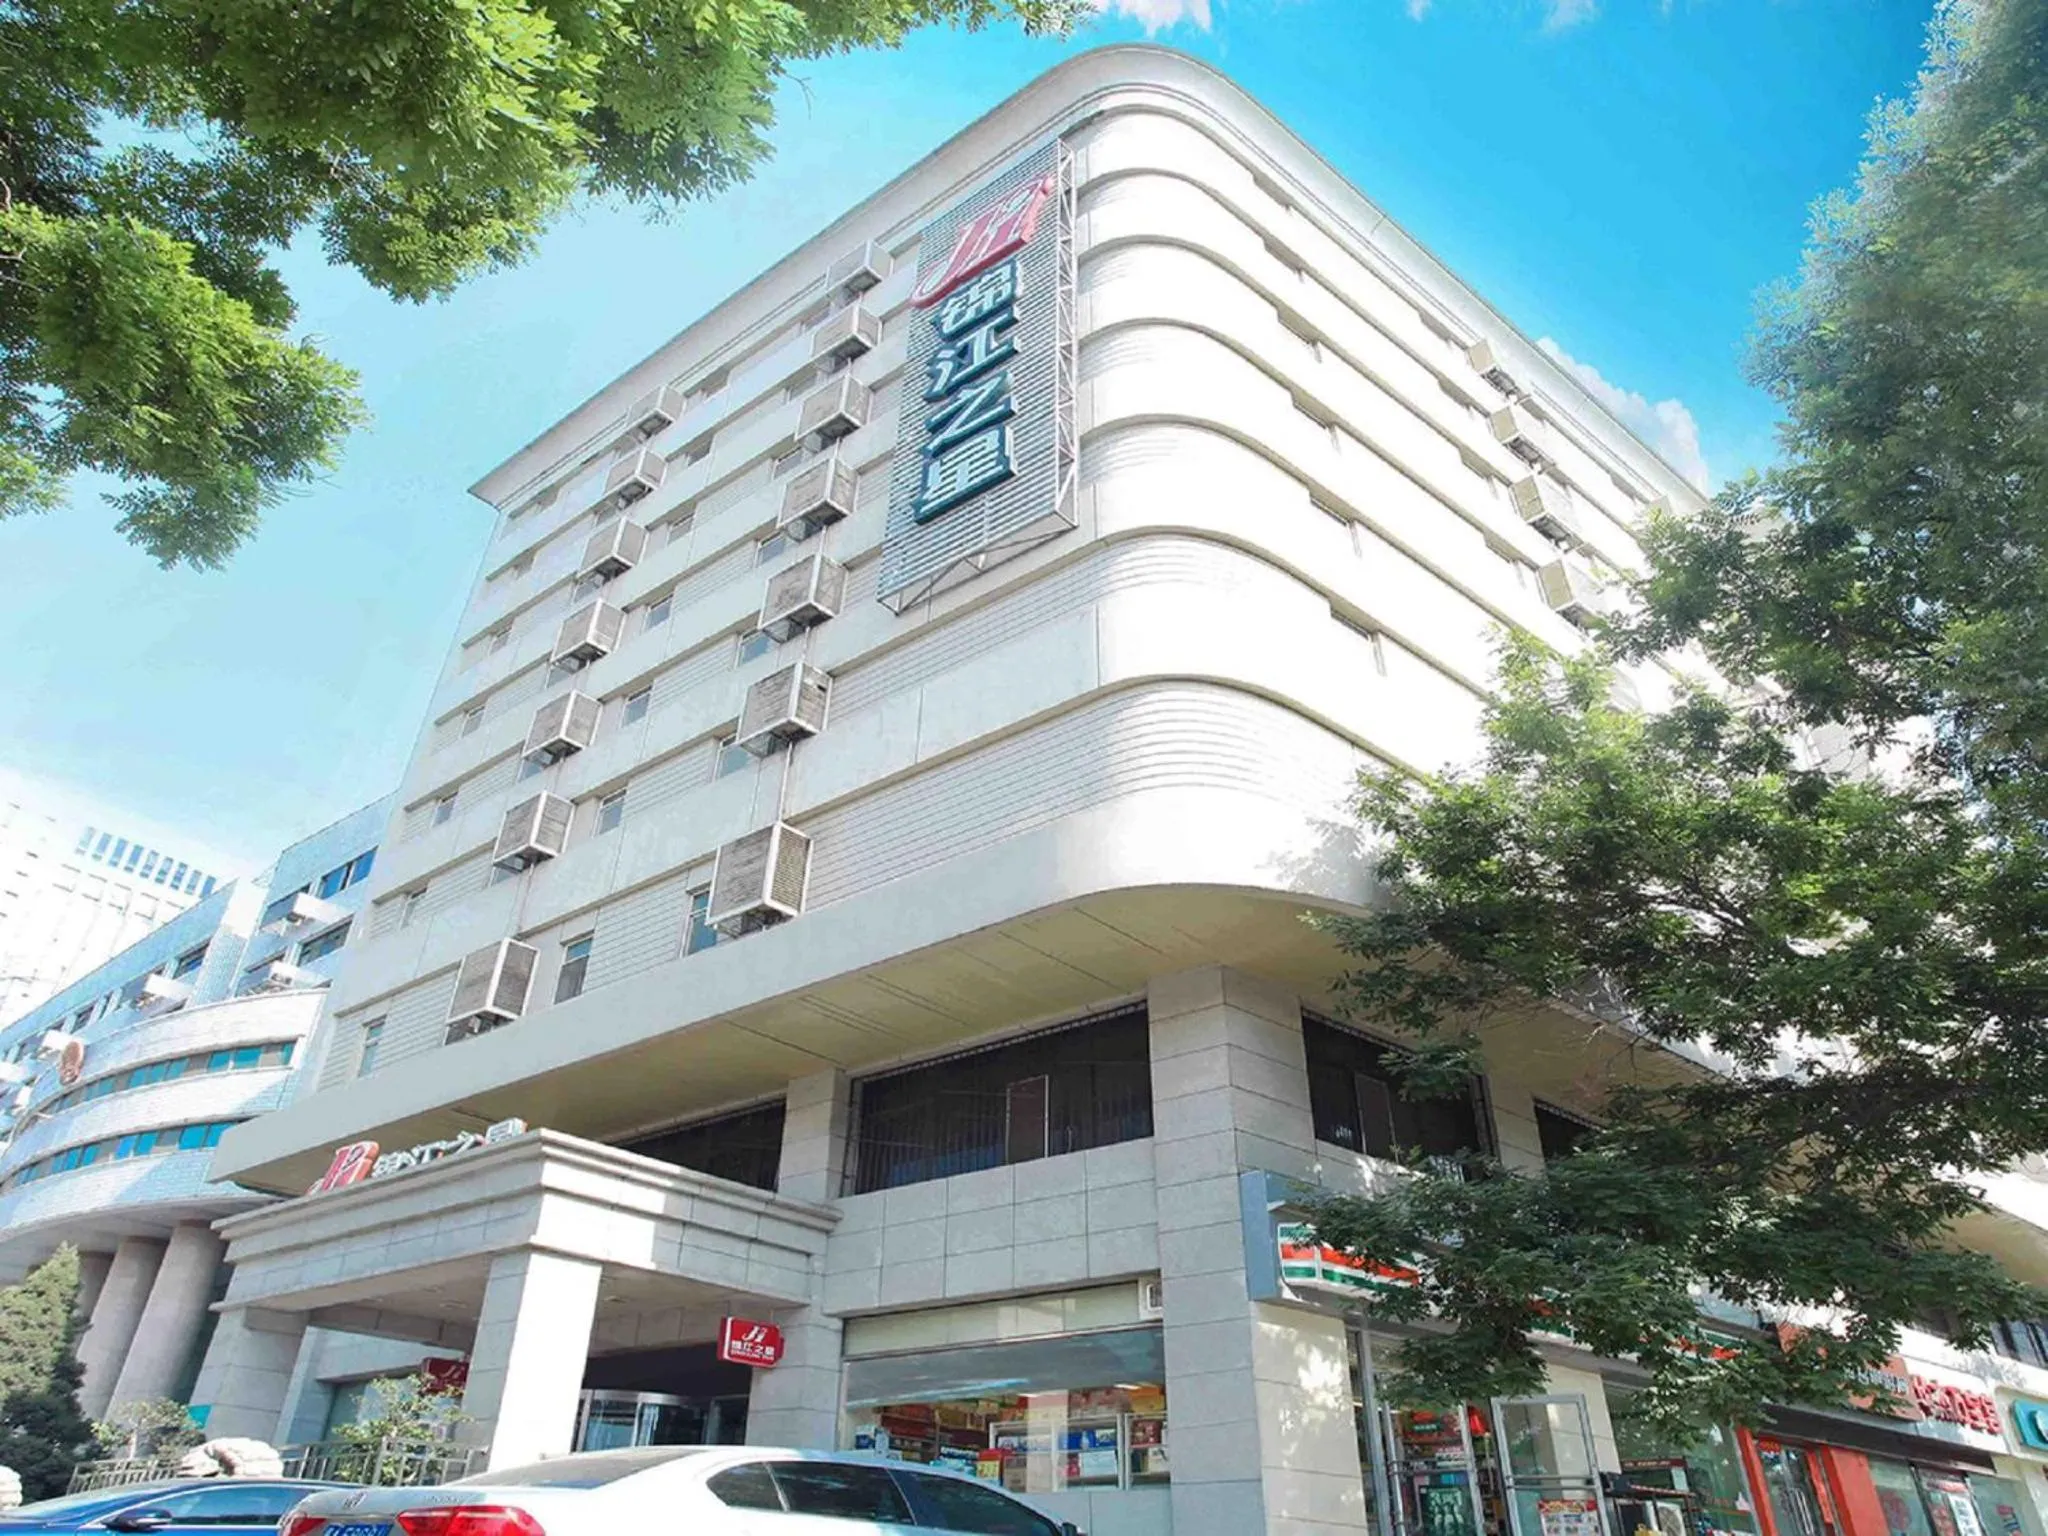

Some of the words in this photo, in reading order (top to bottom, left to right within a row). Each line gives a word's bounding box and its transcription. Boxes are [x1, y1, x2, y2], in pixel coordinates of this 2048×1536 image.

[914, 259, 1020, 524] 锦江之星
[731, 1340, 775, 1356] 锦江之星
